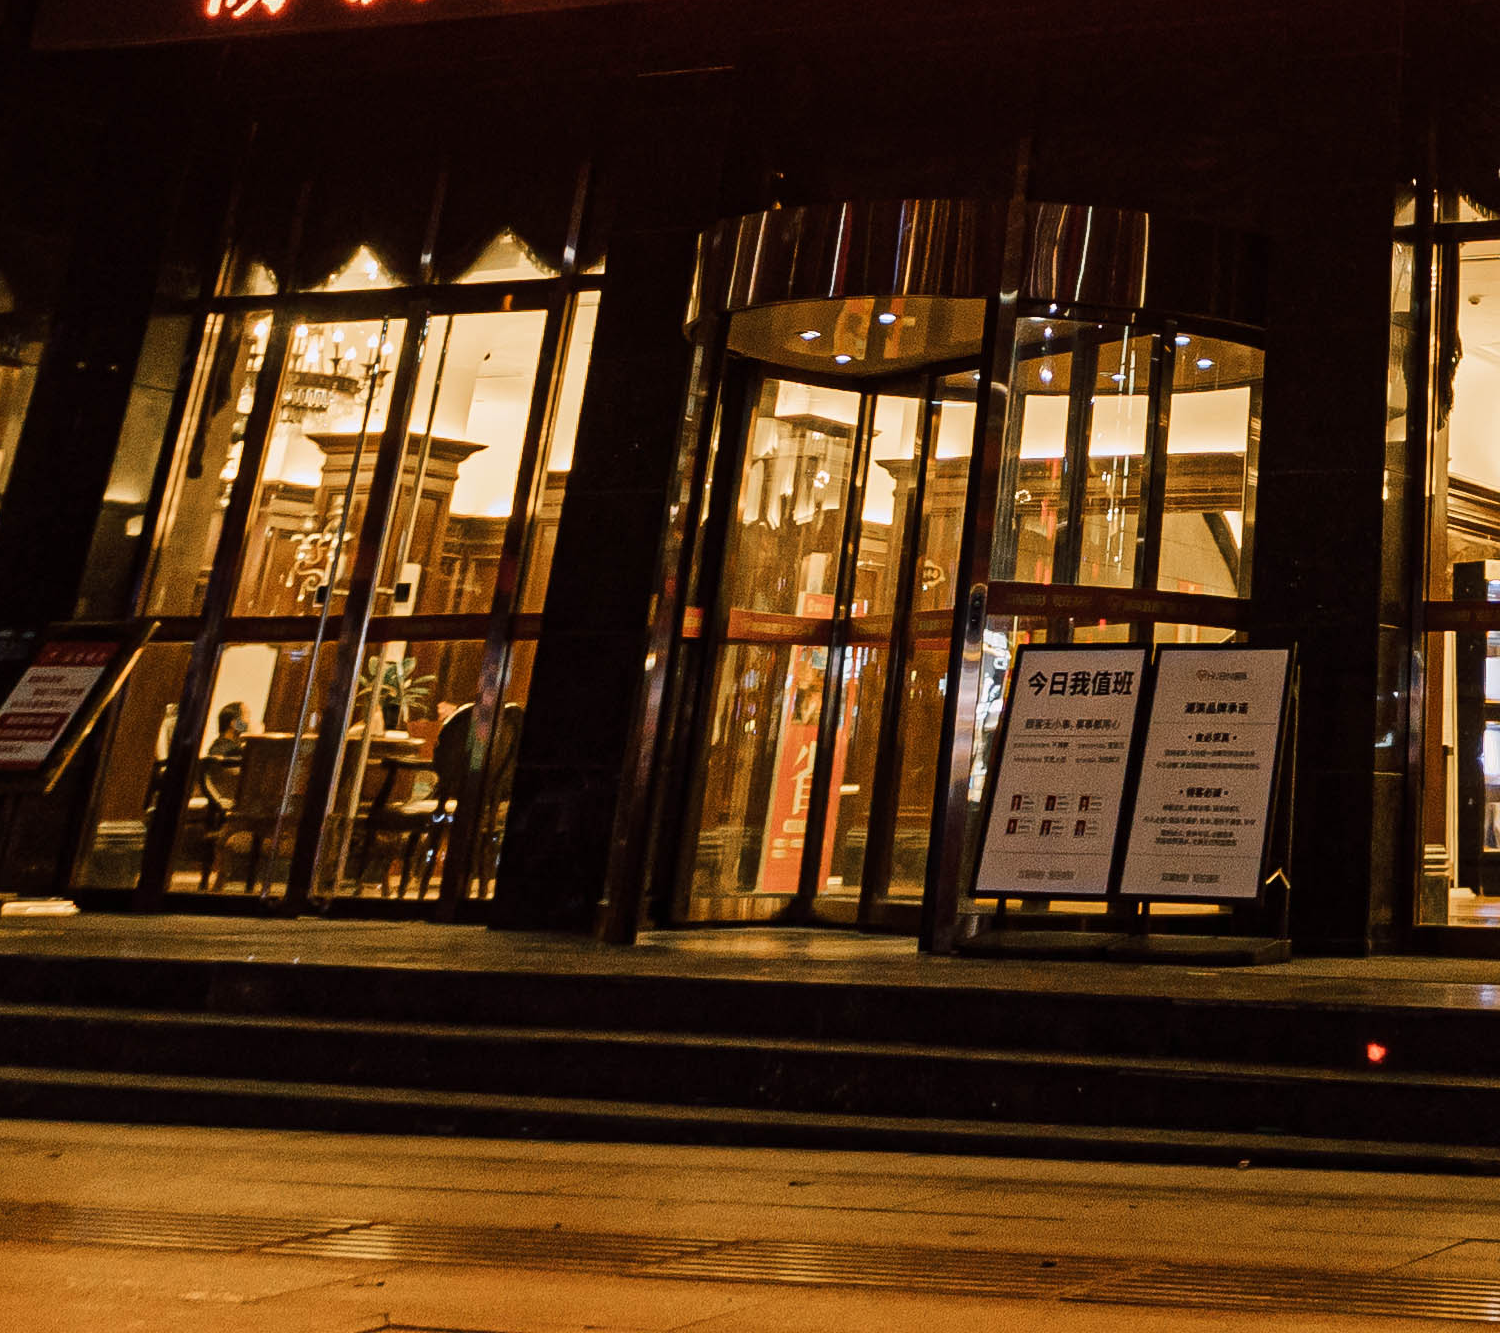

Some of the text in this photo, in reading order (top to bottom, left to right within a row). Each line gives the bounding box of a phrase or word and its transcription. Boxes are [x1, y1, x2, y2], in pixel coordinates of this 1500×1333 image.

[1028, 670, 1134, 696] 今日我值班
